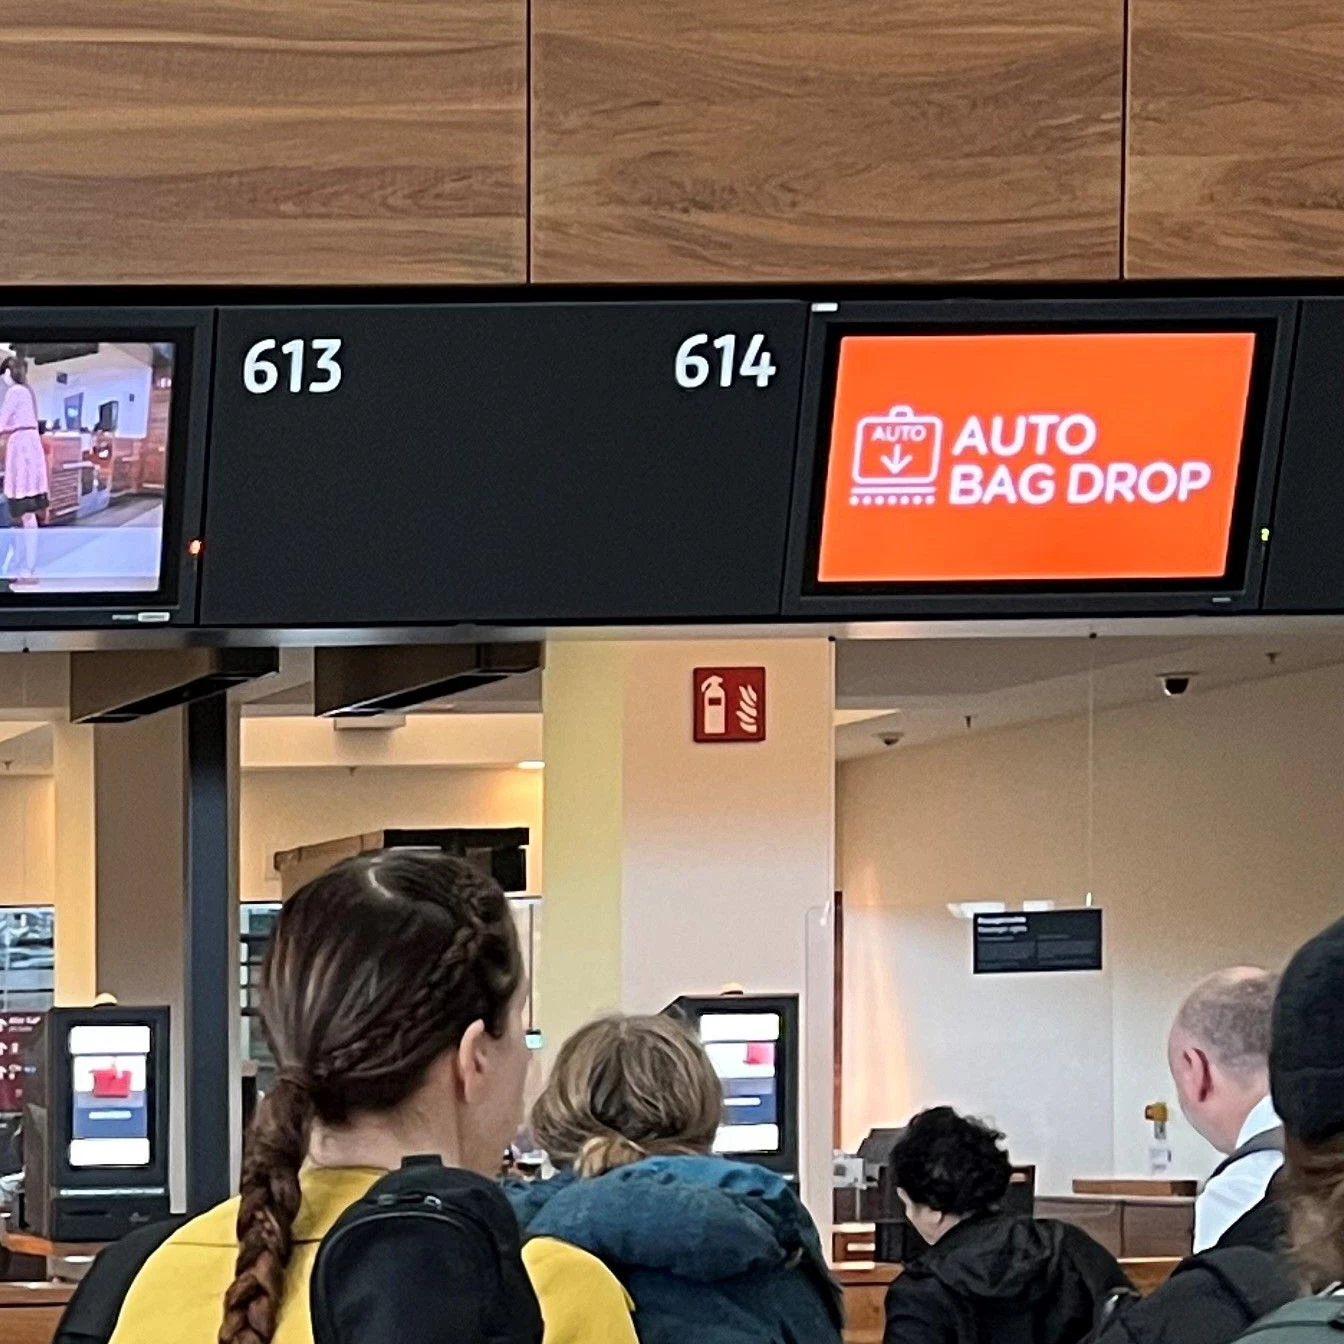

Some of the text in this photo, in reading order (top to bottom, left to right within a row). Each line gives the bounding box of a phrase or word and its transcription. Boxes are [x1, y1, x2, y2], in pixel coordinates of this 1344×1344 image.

[243, 338, 342, 394] 613
[675, 333, 777, 388] 614
[872, 422, 926, 442] AUTO
[951, 413, 1099, 458] AUTO
[948, 459, 1213, 506] BAG DROP
